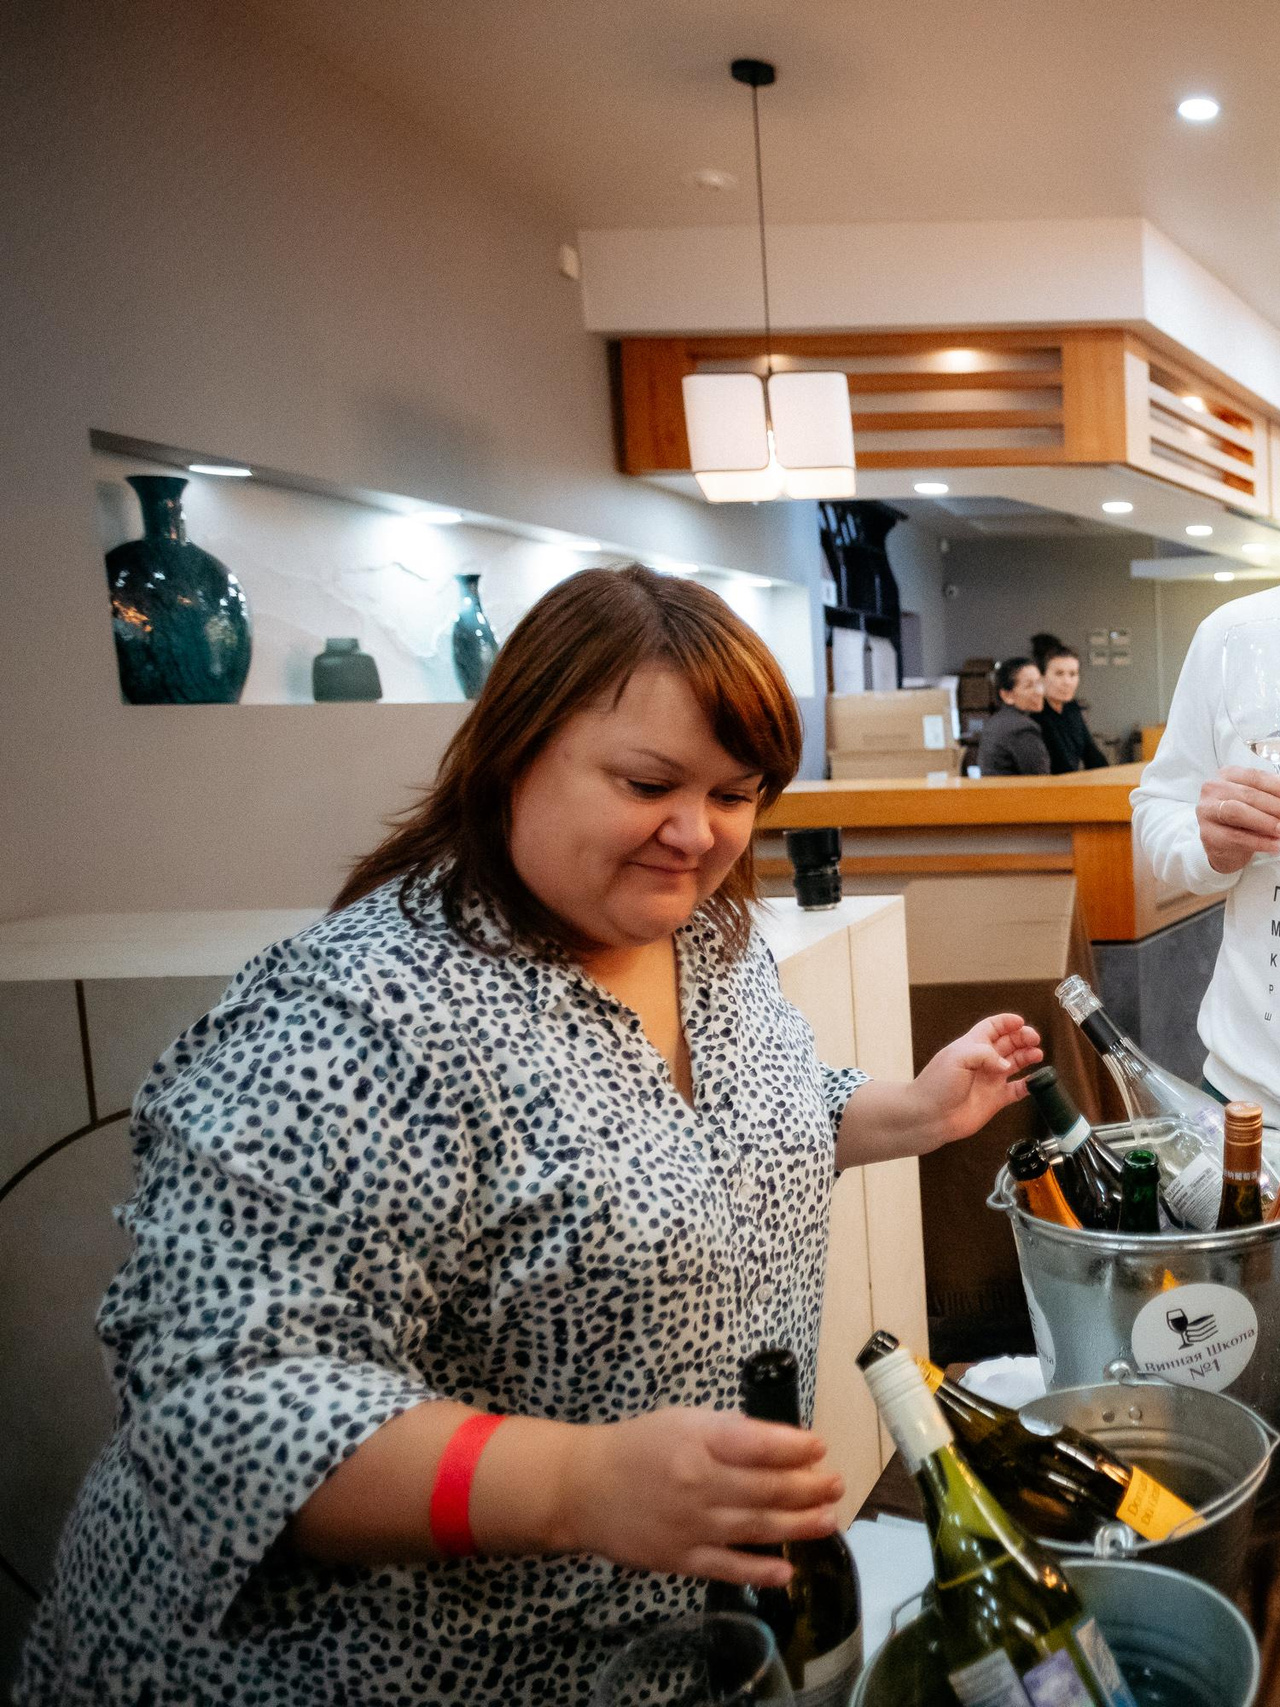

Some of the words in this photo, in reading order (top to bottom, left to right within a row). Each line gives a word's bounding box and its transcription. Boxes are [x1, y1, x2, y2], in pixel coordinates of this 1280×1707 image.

[1145, 1352, 1202, 1373] Винная
[1206, 1328, 1255, 1356] Школа
[1189, 1359, 1221, 1381] №1
